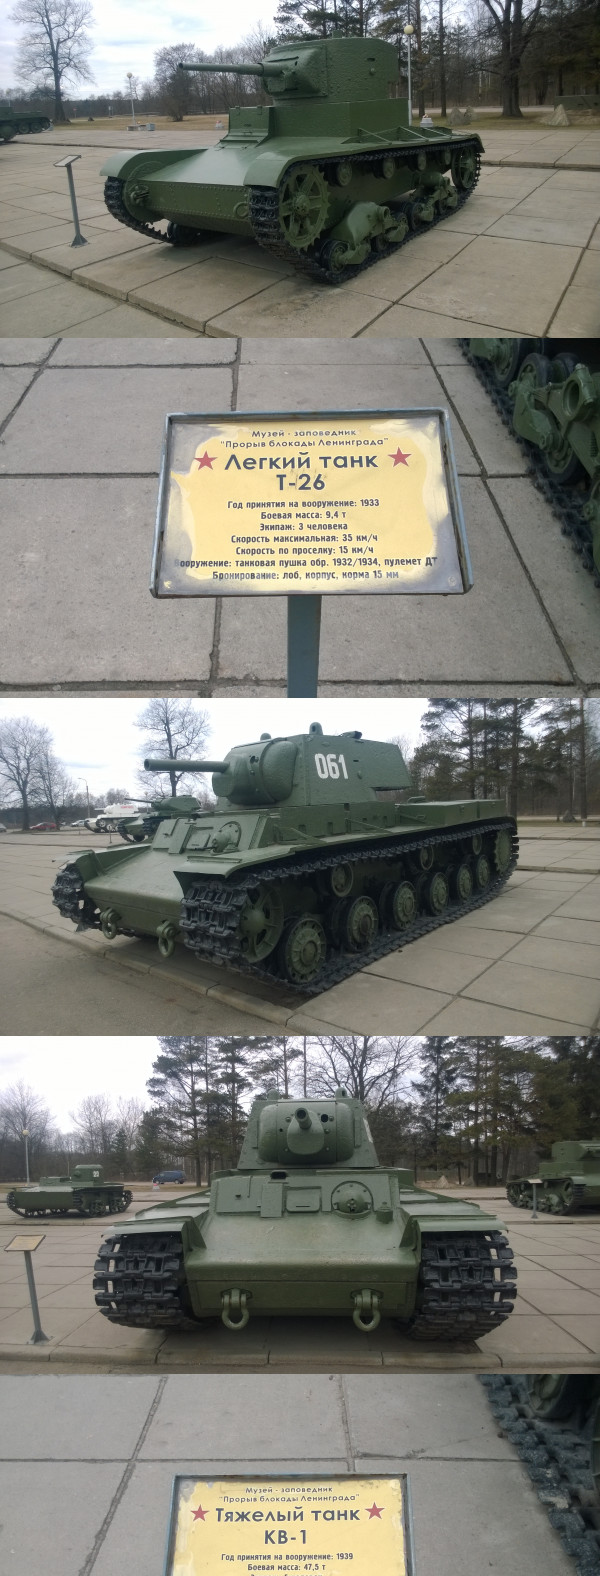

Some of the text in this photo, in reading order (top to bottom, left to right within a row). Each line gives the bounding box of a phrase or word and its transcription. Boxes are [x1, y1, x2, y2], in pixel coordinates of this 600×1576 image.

[225, 452, 378, 470] Легкий танк
[276, 474, 325, 490] Т-26
[228, 501, 243, 509] Год
[231, 535, 270, 544] Скорость
[356, 534, 377, 542] км/ч
[235, 559, 275, 567] танковая
[279, 560, 307, 568] пушка
[310, 558, 329, 567] обр.
[384, 559, 421, 567] пулемет
[425, 557, 438, 567] ДТ
[314, 752, 348, 780] 061
[216, 1506, 360, 1522] Тяжелый танк
[265, 1530, 306, 1544] КВ-1
